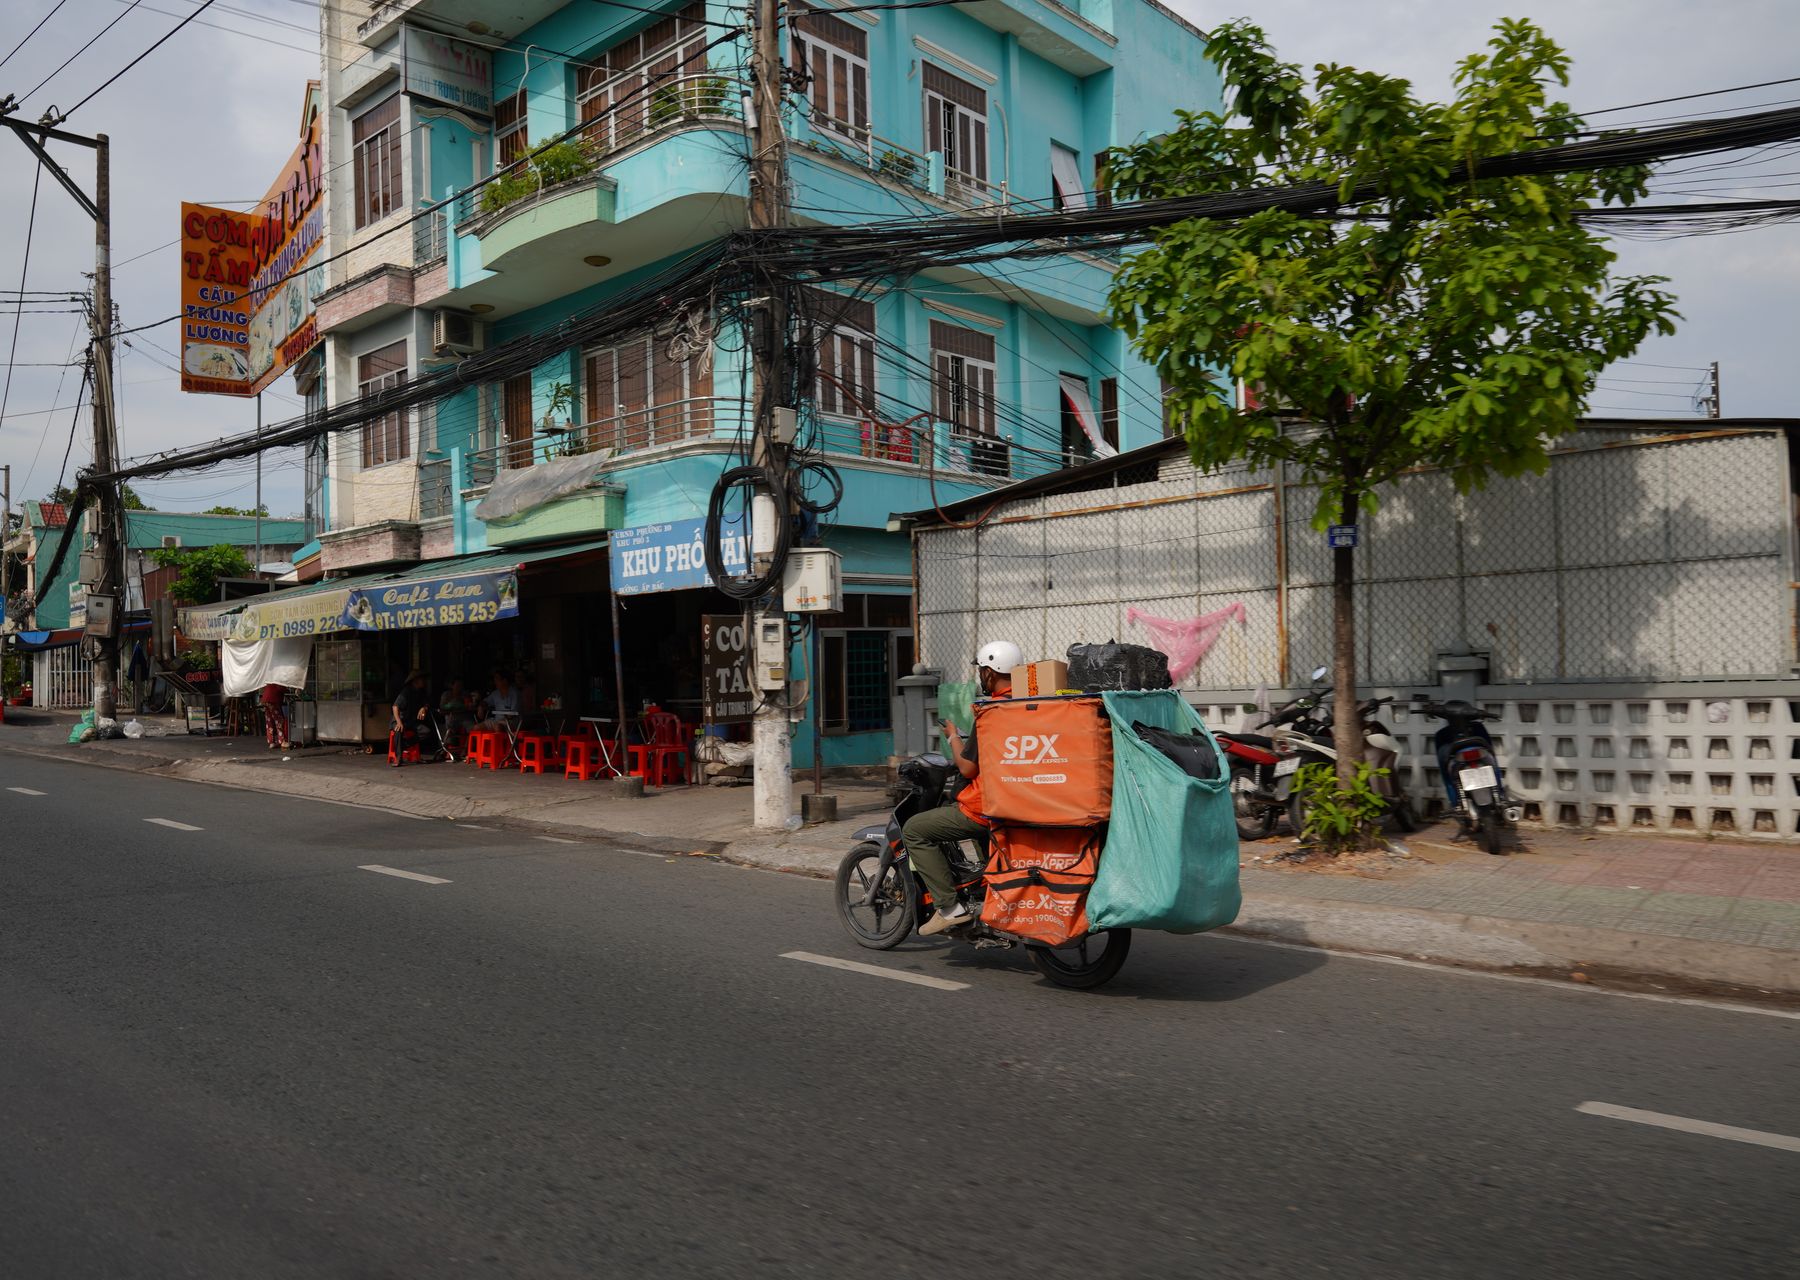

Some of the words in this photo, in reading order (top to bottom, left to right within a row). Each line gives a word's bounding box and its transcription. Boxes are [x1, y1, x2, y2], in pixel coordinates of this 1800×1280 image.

[185, 211, 249, 248] CƠM
[184, 245, 250, 288] TẤM
[199, 285, 236, 305] CẦU
[186, 304, 249, 326] TRUNG
[186, 323, 249, 345] LƯƠNG
[622, 545, 662, 578] KHU
[665, 527, 706, 573] PHỐ
[383, 588, 430, 607] Café
[434, 582, 484, 600] Lan
[439, 603, 465, 624] 855
[468, 600, 499, 622] 253
[283, 618, 315, 637] 0989
[1002, 733, 1060, 765] SPX
